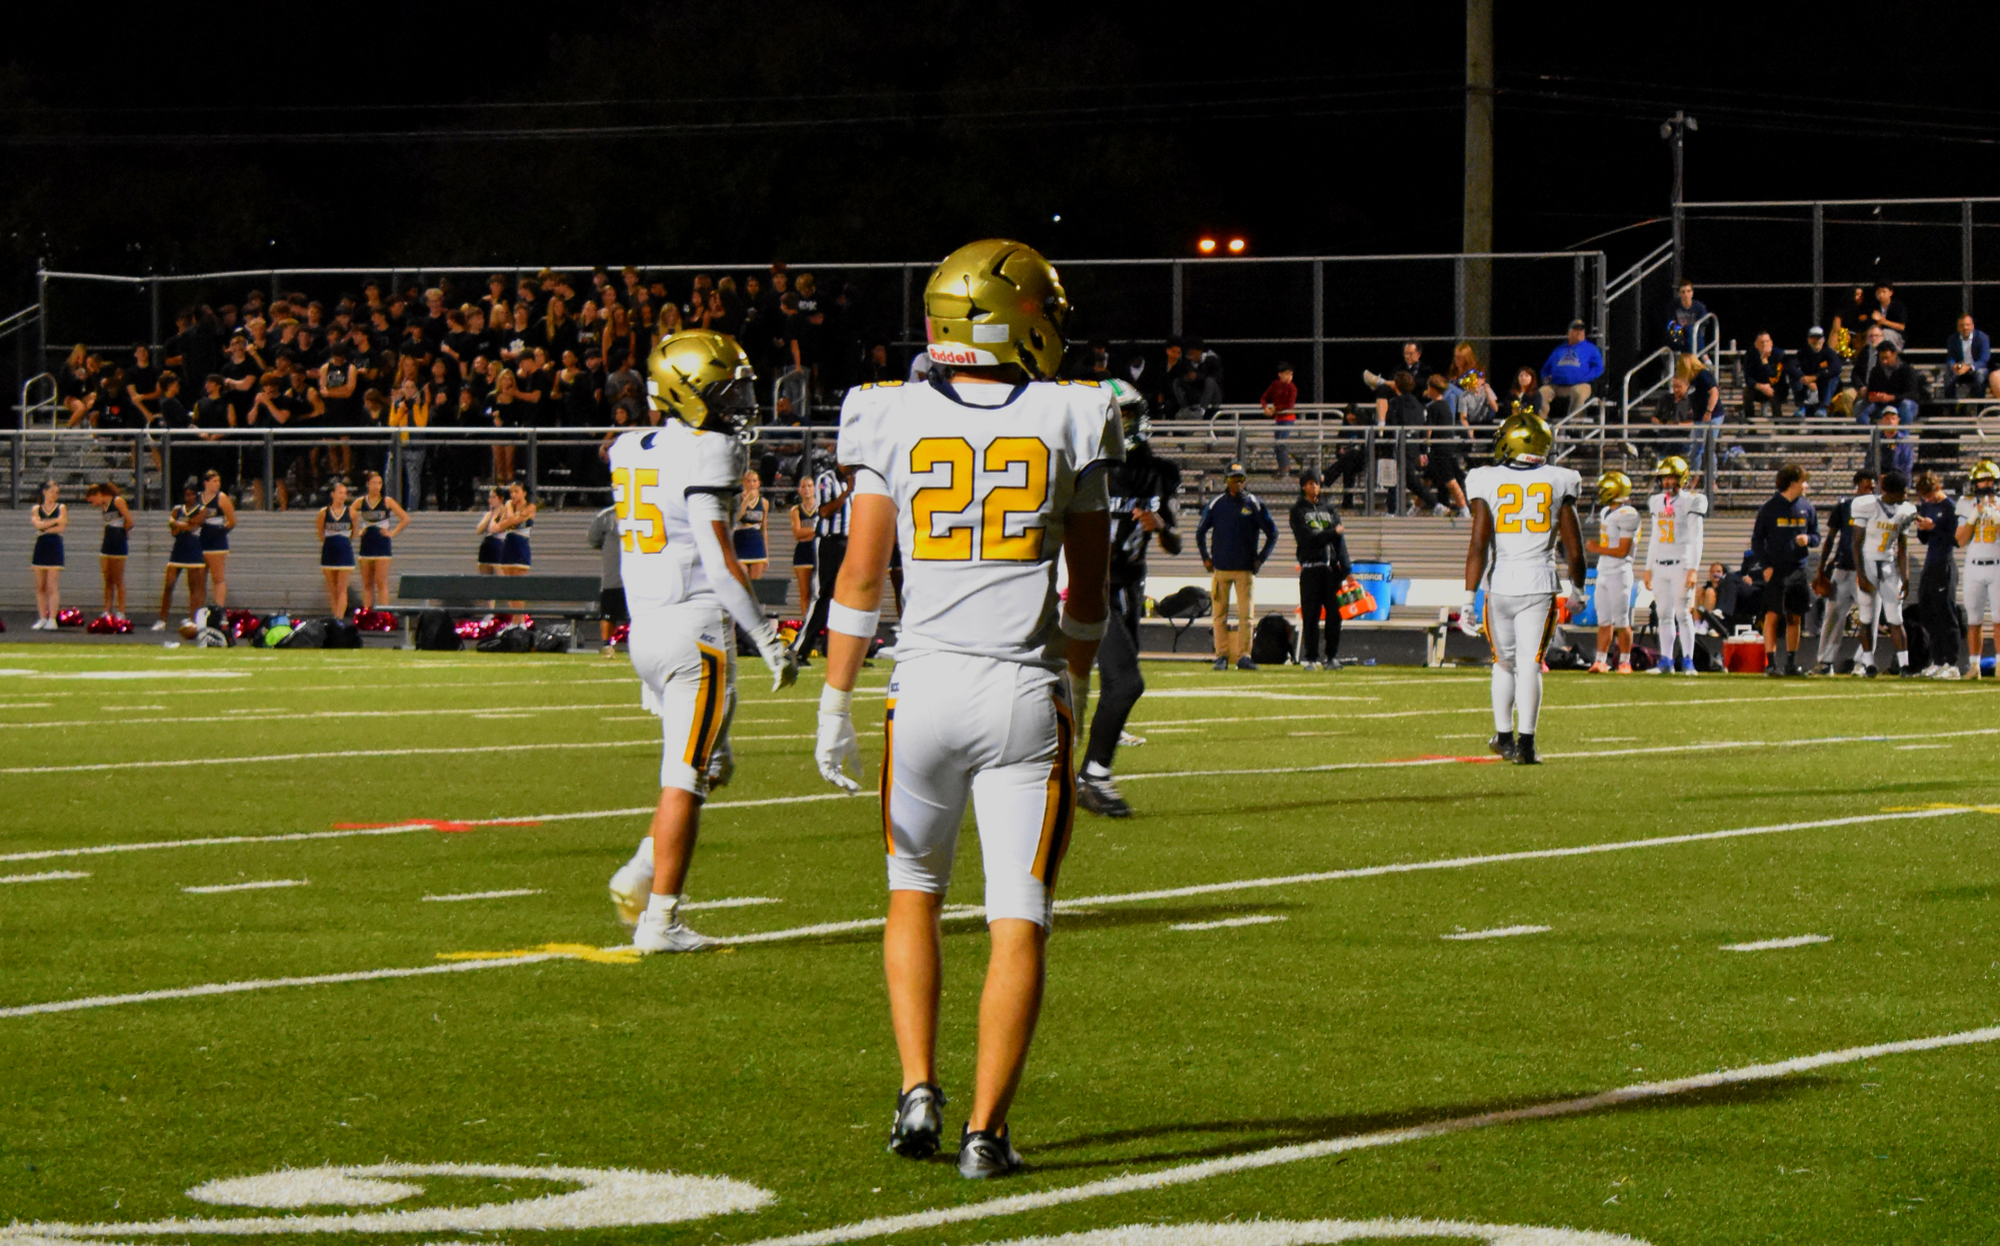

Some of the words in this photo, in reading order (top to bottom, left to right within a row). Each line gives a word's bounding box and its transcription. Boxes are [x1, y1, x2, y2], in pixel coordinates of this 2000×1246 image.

[611, 466, 668, 554] 25
[909, 436, 1050, 561] 22
[1496, 482, 1553, 533] 23
[1658, 519, 1675, 543] 51
[1878, 531, 1890, 553] 1
